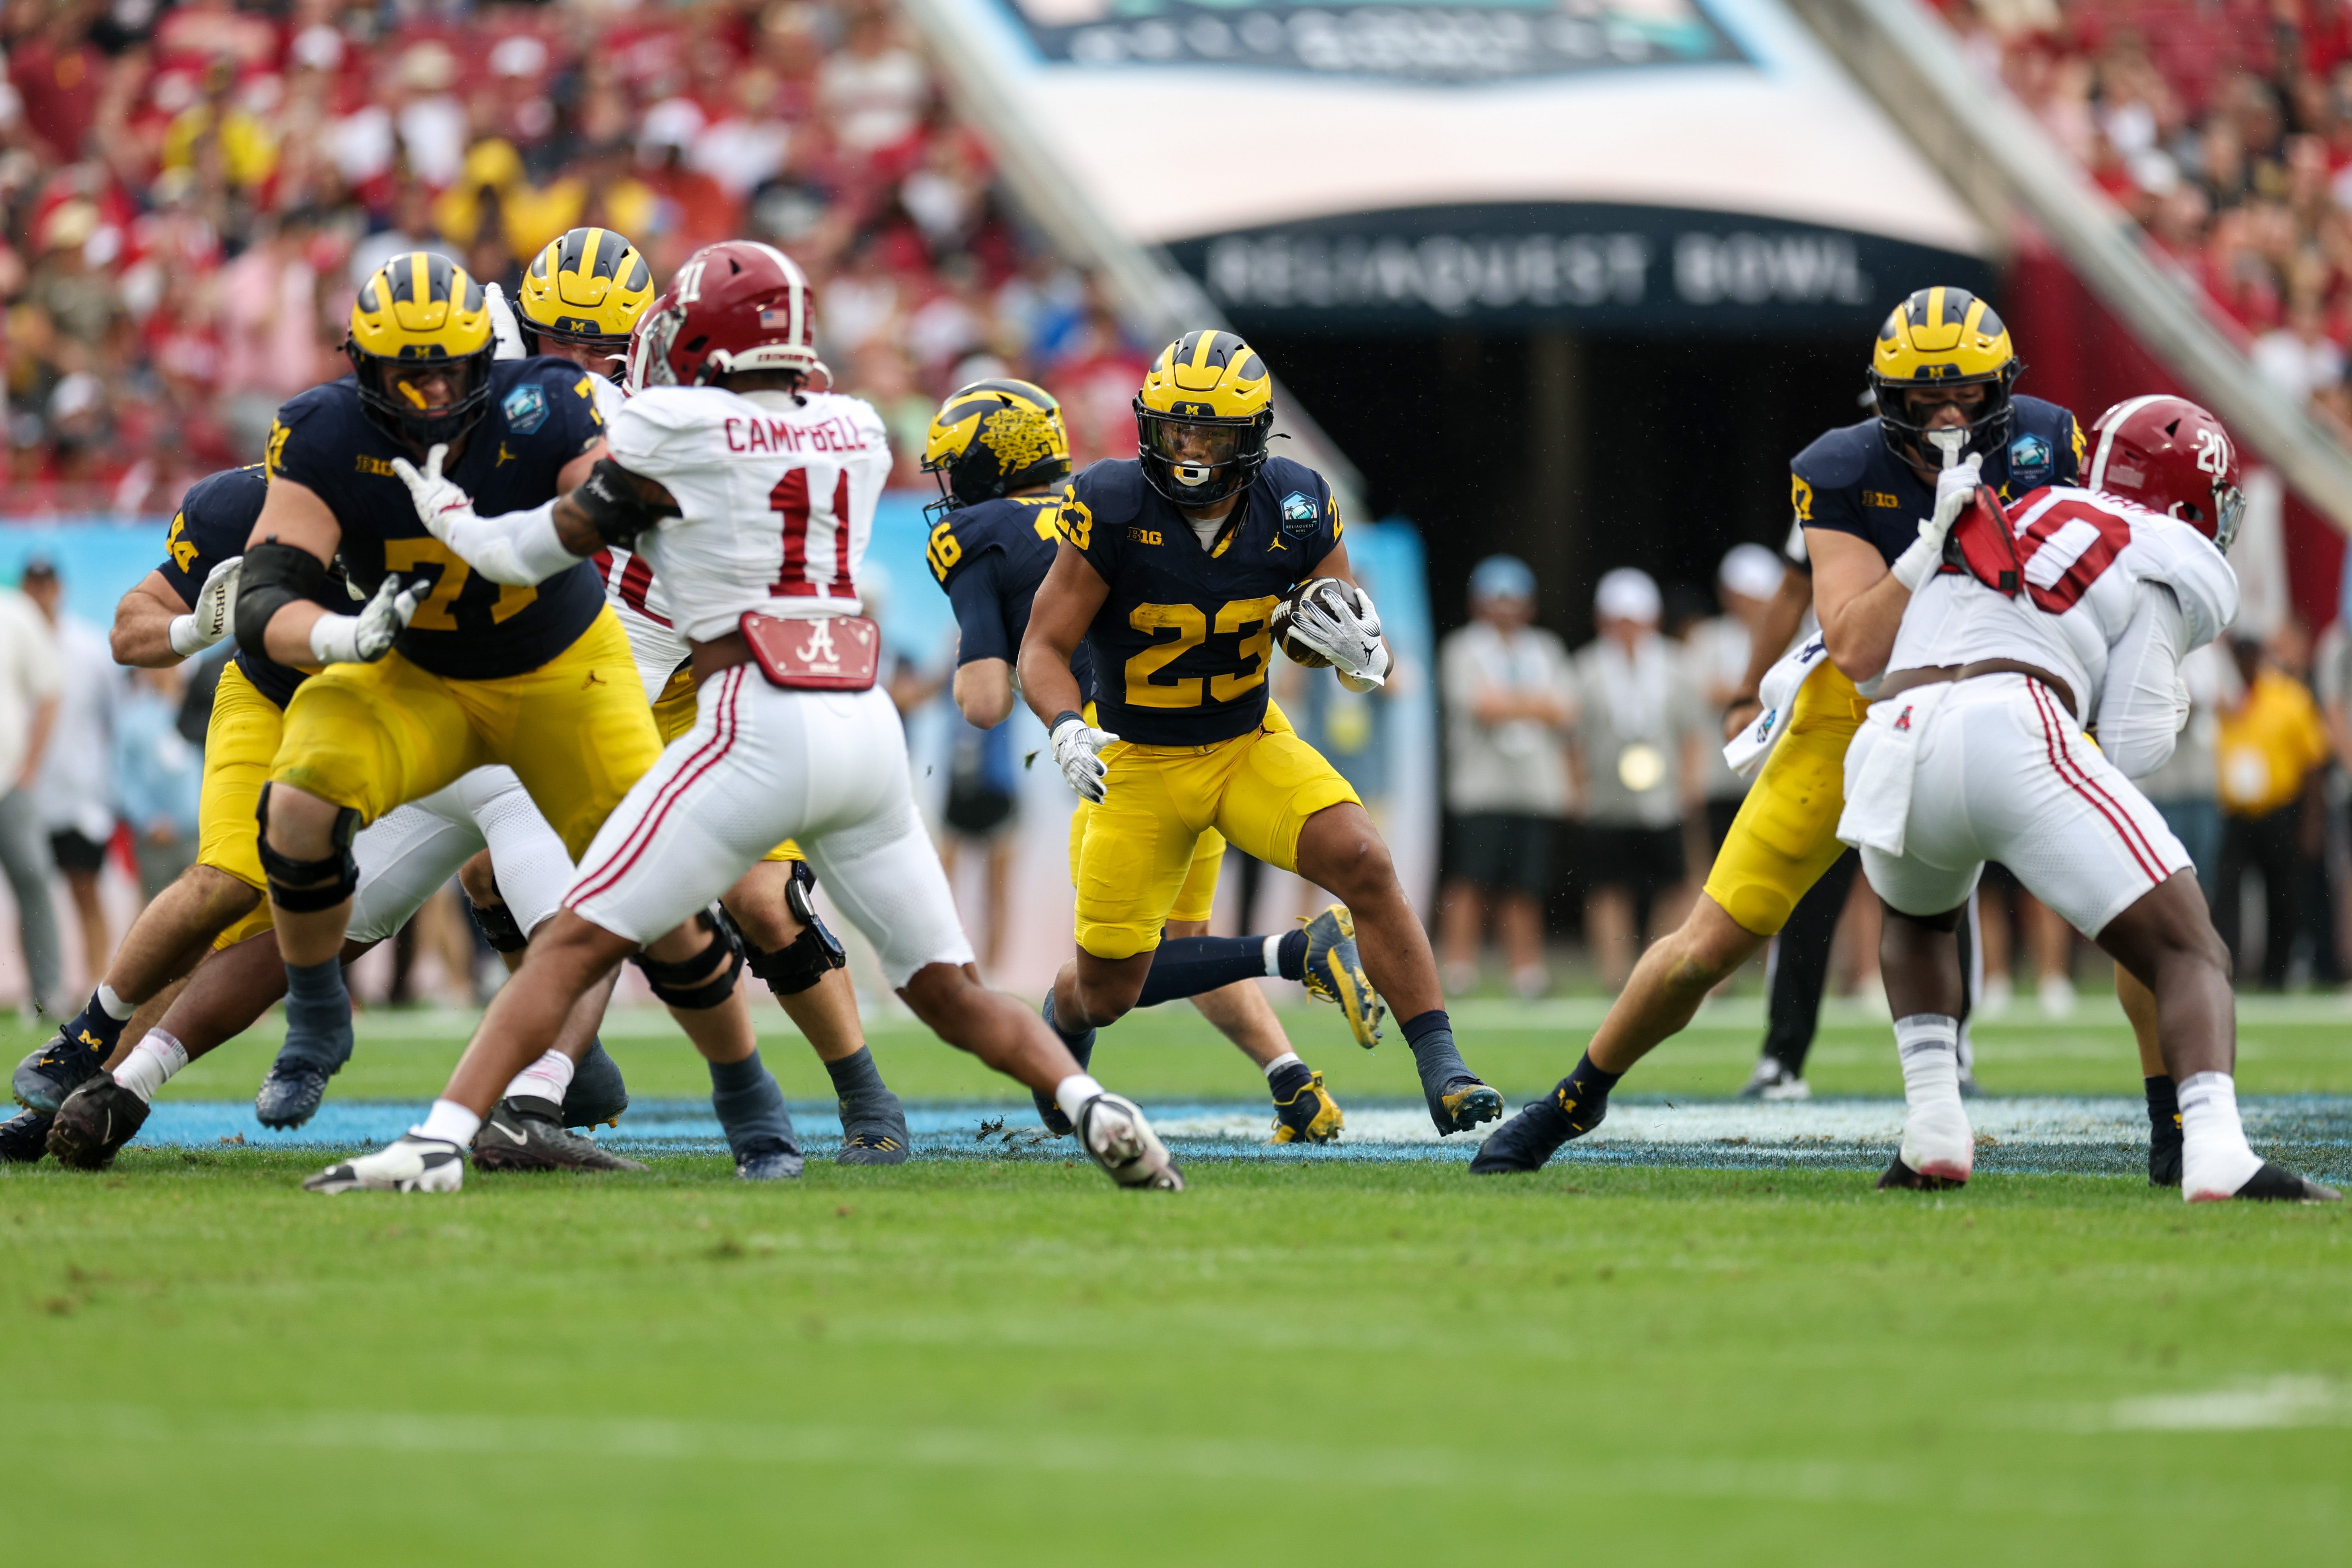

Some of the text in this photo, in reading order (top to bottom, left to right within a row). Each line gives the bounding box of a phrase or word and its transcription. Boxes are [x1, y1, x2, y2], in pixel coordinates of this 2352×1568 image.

[1671, 230, 1872, 306] BOWL
[414, 347, 431, 358] M
[570, 321, 585, 333] M
[725, 416, 867, 452] CAMPBELL
[1185, 405, 1199, 415] M
[2196, 427, 2229, 476] 20
[768, 466, 857, 599] 11
[1056, 484, 1092, 551] 23
[926, 522, 962, 583] 16
[1125, 594, 1281, 708] 23
